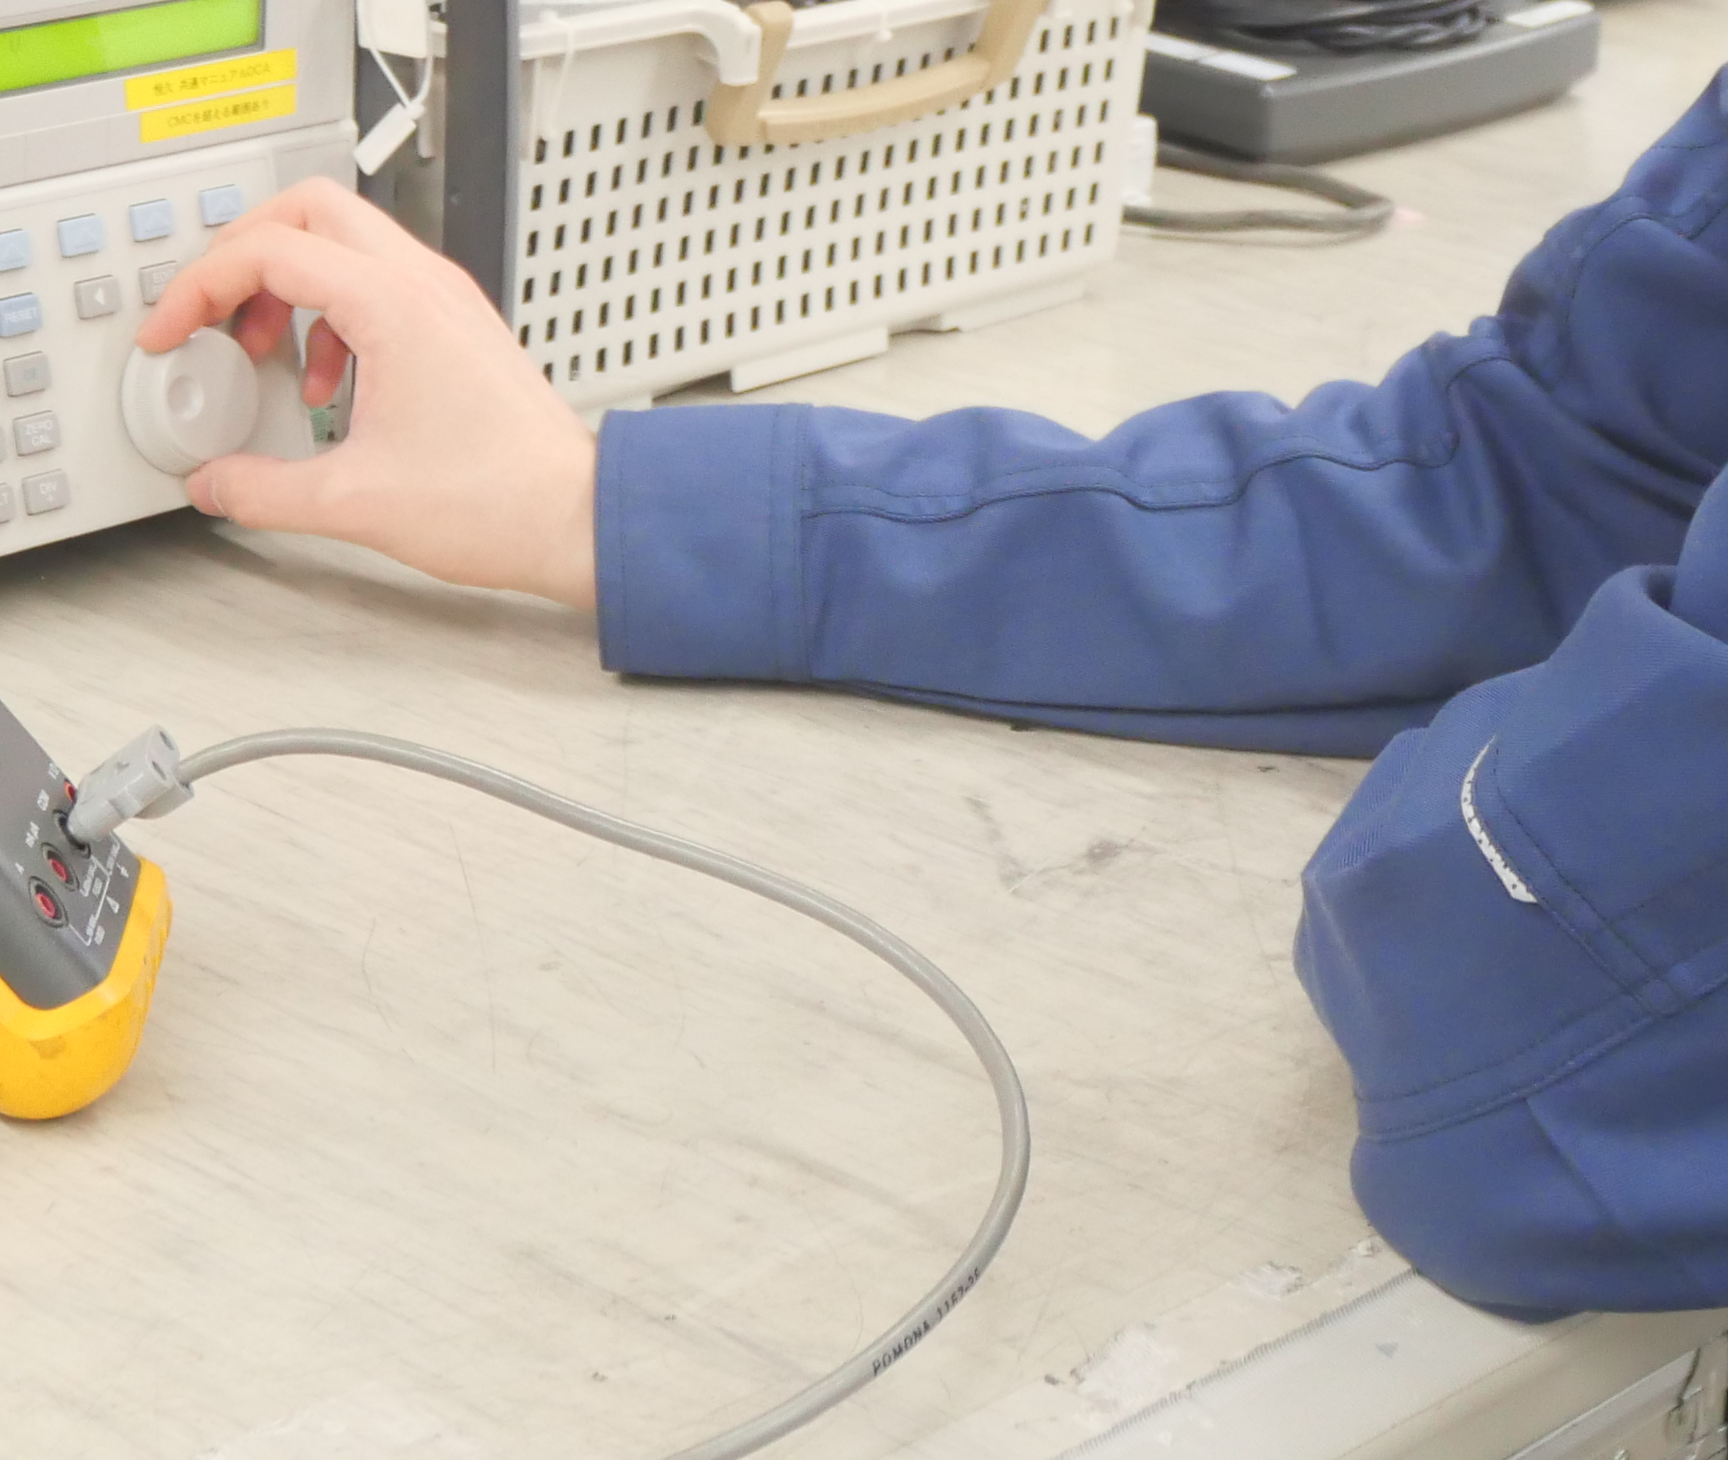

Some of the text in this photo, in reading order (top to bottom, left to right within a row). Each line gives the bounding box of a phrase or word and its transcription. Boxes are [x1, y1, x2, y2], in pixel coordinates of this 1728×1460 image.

[4, 306, 39, 324] RESET
[25, 421, 54, 436] ZERO
[39, 481, 58, 495] DIV
[871, 1319, 931, 1378] POMONA
